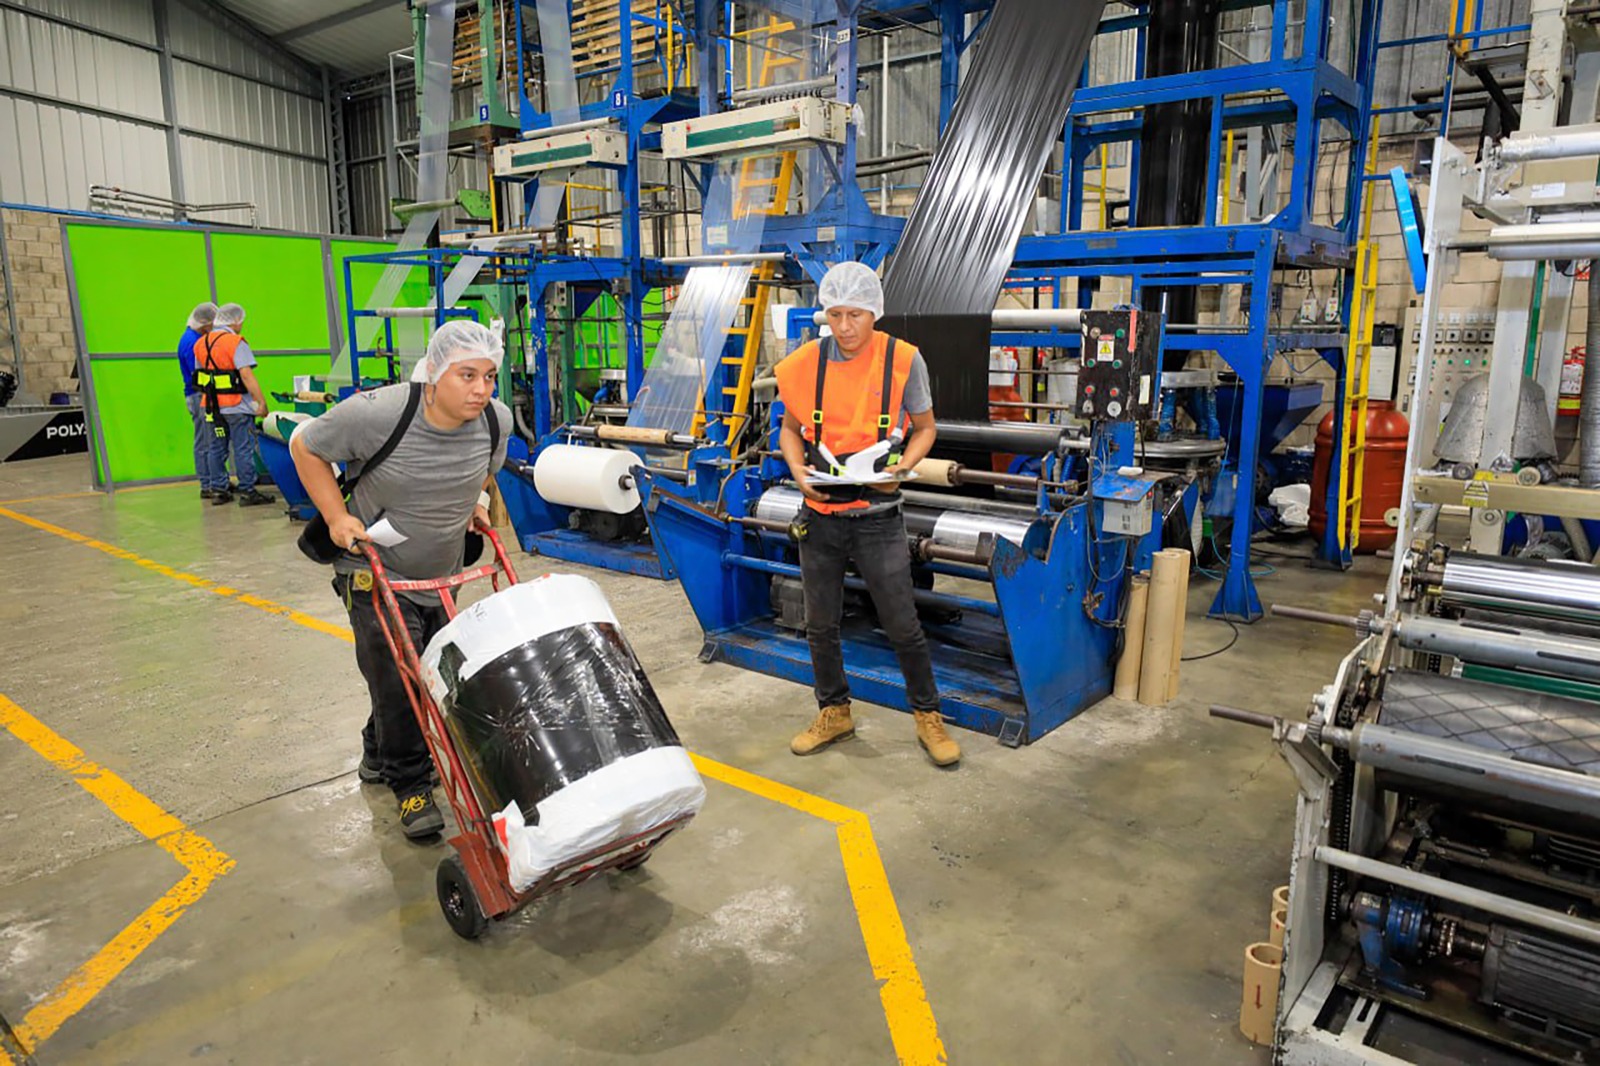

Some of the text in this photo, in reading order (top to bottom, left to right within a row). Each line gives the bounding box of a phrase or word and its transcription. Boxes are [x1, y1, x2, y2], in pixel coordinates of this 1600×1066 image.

[615, 92, 621, 106] 8
[481, 108, 487, 119] 9
[46, 423, 87, 439] POLY
